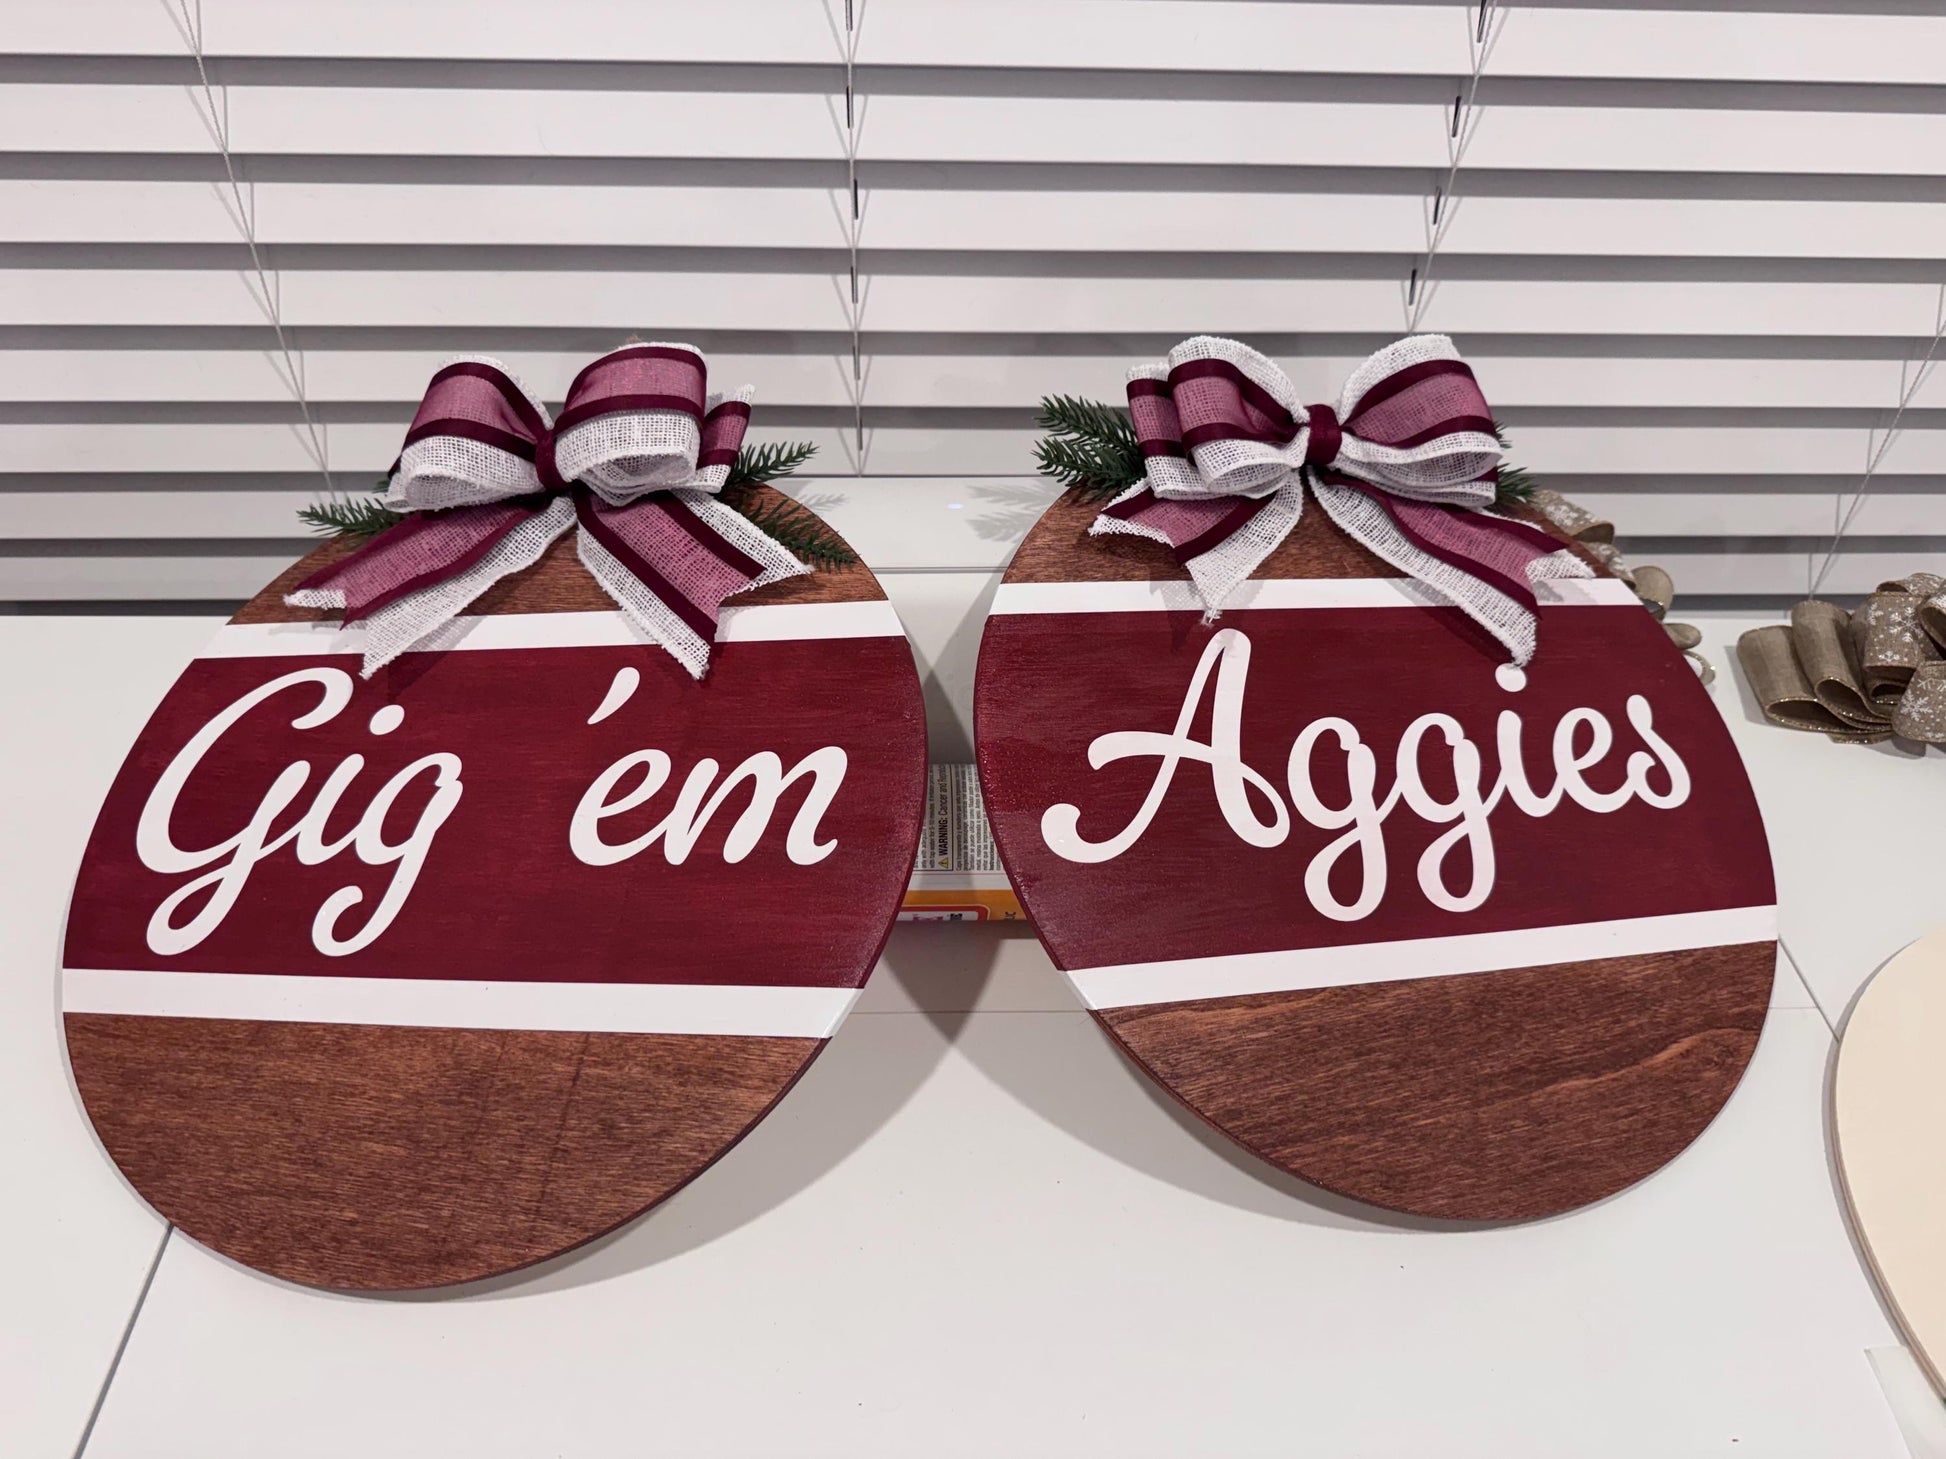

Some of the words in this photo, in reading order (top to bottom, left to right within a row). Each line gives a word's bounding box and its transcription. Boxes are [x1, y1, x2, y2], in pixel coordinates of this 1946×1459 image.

[938, 782, 947, 793] and
[1041, 628, 1690, 921] Aggies
[137, 667, 464, 957] Gig
[938, 794, 948, 816] Cancer
[938, 818, 948, 856] WARNING:
